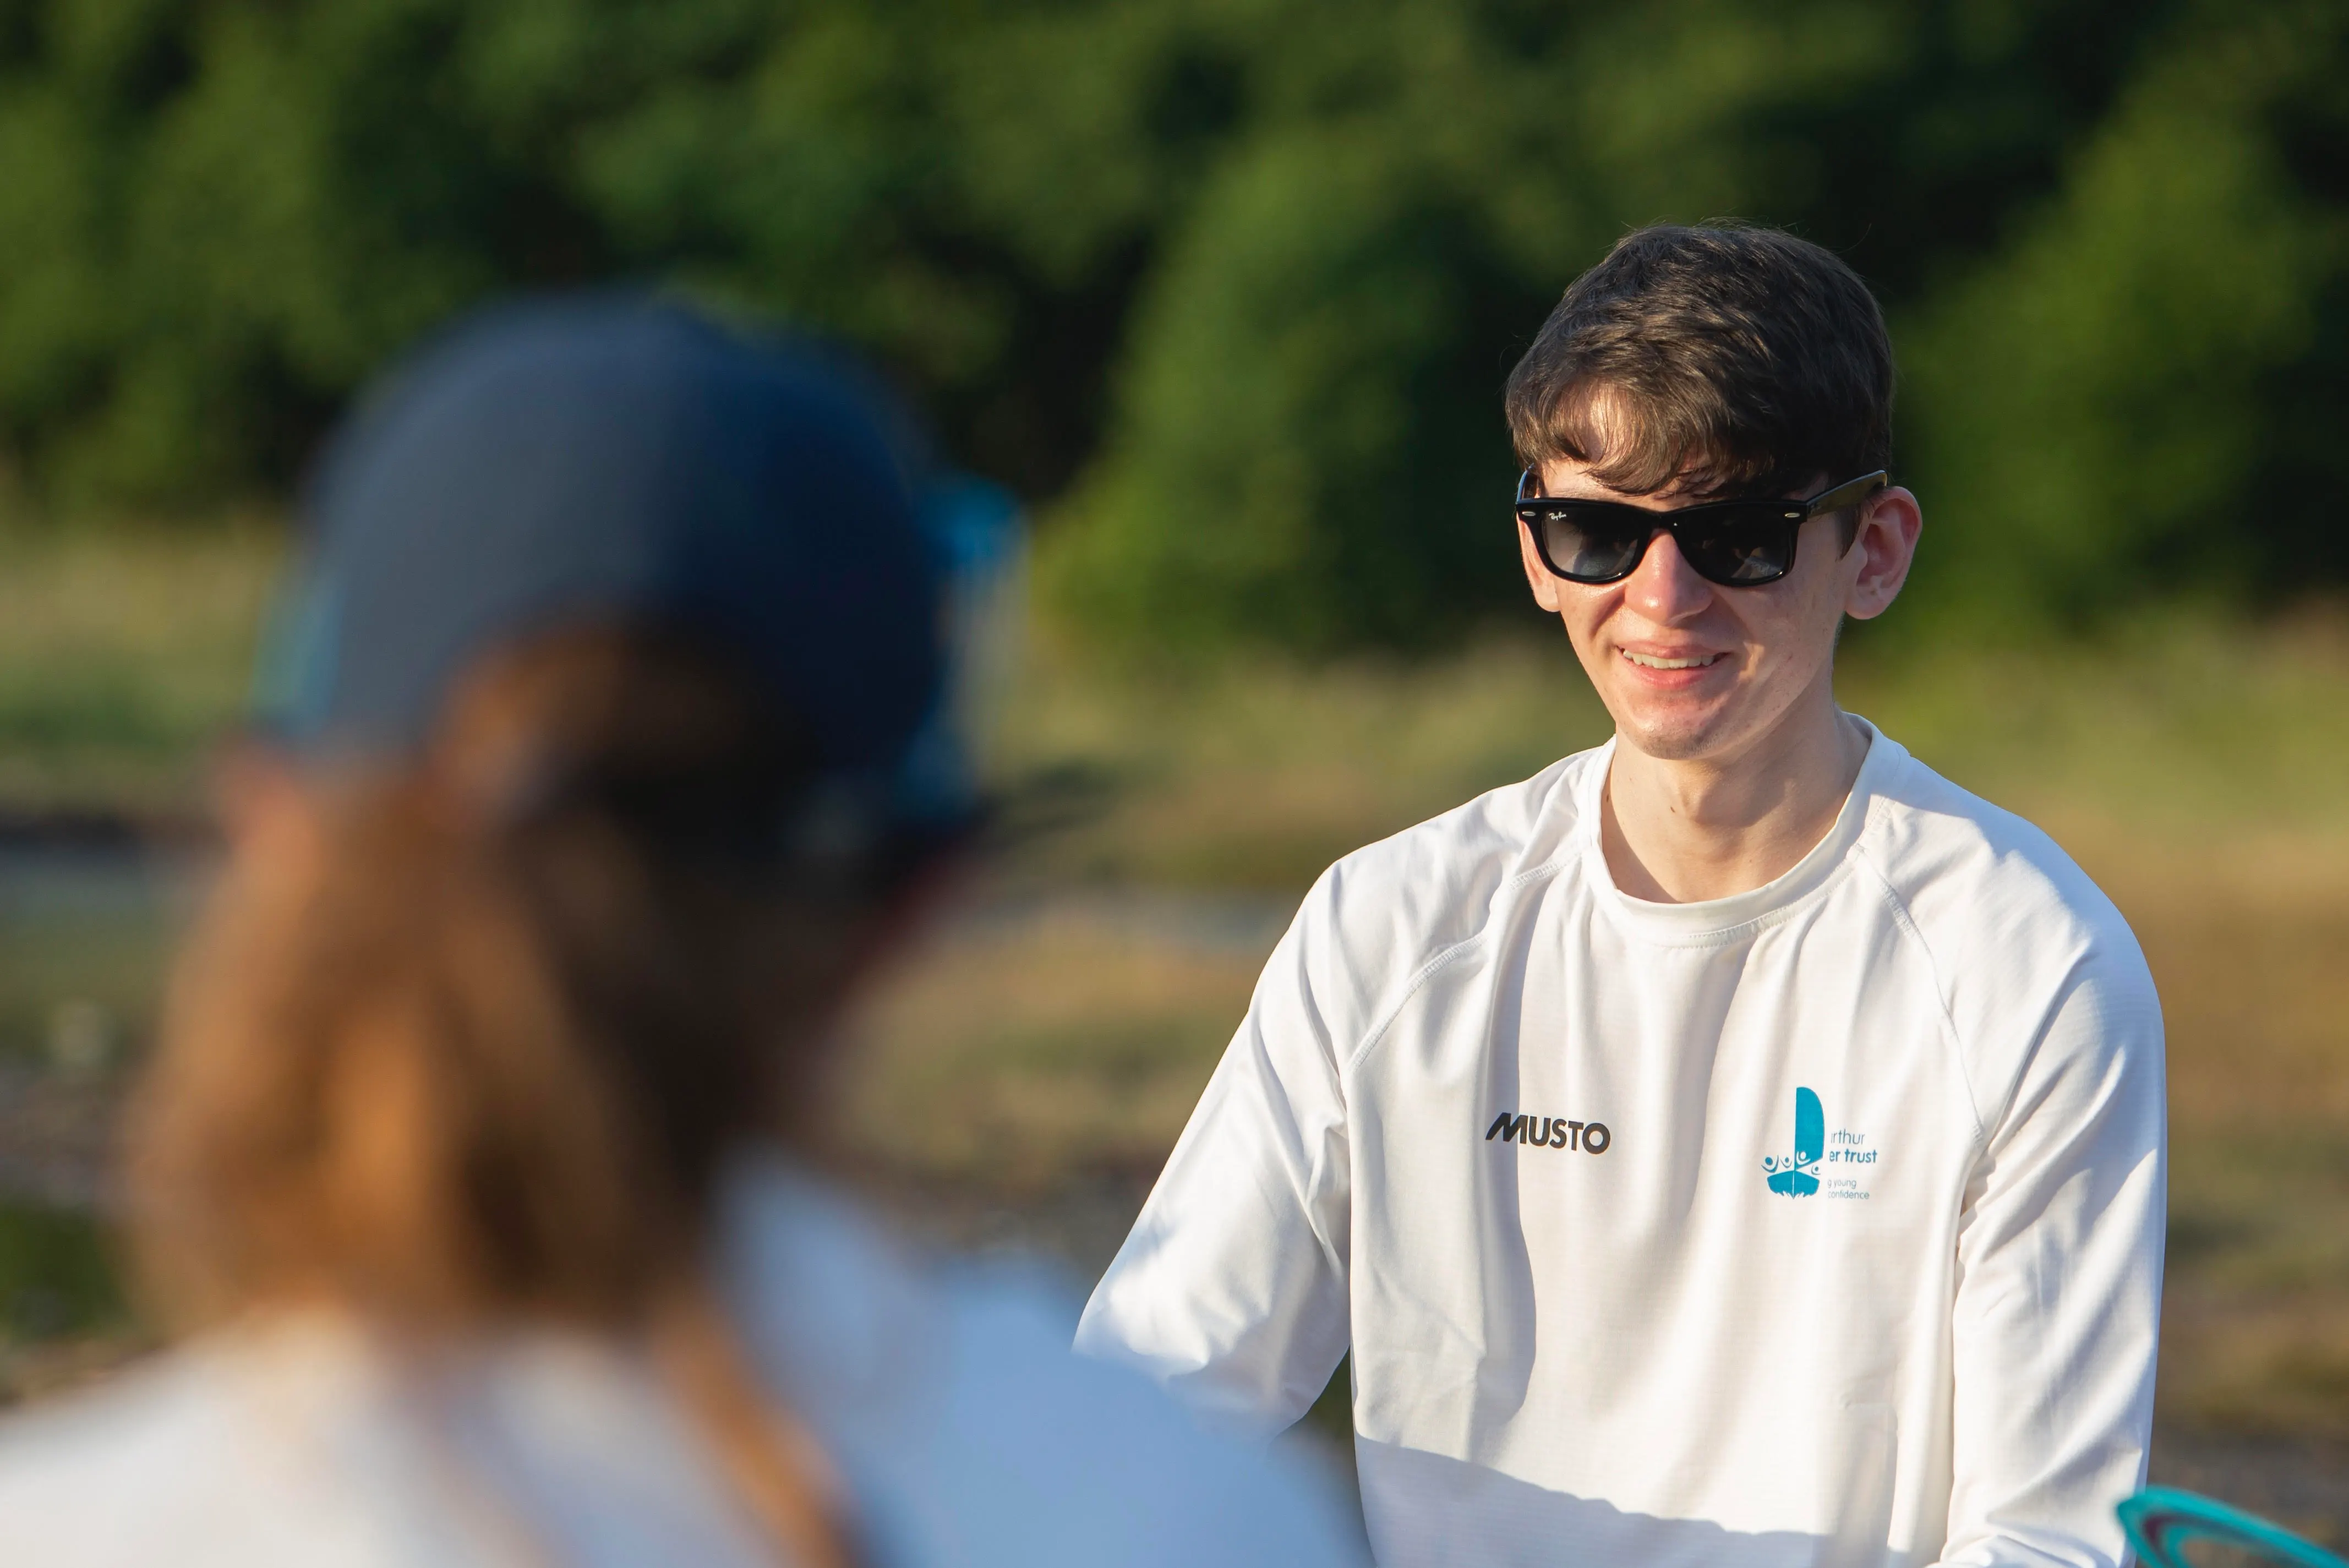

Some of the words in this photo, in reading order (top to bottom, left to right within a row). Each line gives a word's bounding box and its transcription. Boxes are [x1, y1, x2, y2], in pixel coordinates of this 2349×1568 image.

[1485, 1112, 1610, 1154] MUSTO
[1831, 1128, 1865, 1145] rthur
[1844, 1148, 1878, 1163] trust
[1834, 1179, 1856, 1189] young
